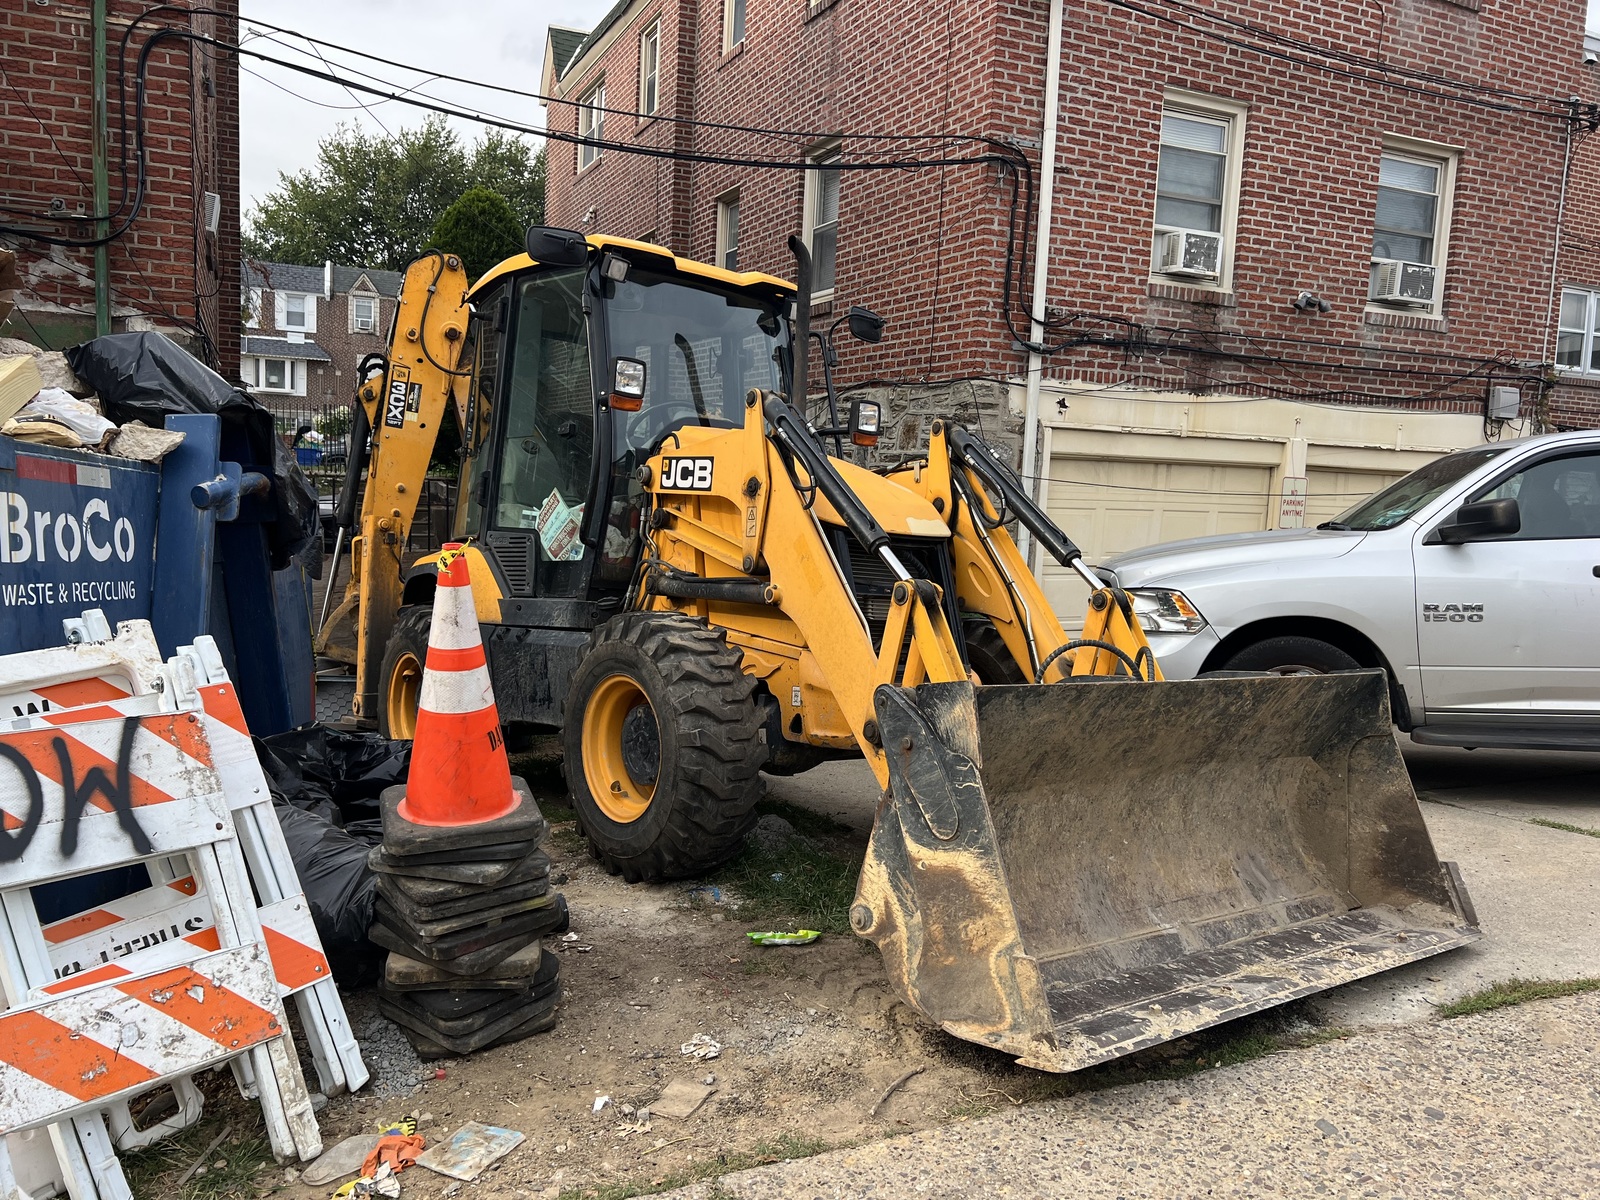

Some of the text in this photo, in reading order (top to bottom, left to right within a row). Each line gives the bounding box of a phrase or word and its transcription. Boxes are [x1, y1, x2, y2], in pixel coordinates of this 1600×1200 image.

[387, 381, 406, 419] 3CX
[661, 458, 713, 488] JCB
[1282, 499, 1304, 507] PARKING
[1282, 509, 1303, 517] ANYTIME
[0, 491, 135, 563] BroCo
[2, 580, 136, 606] WASTE & RECYCLING
[1423, 602, 1484, 612] RAM
[1423, 613, 1484, 622] 1500
